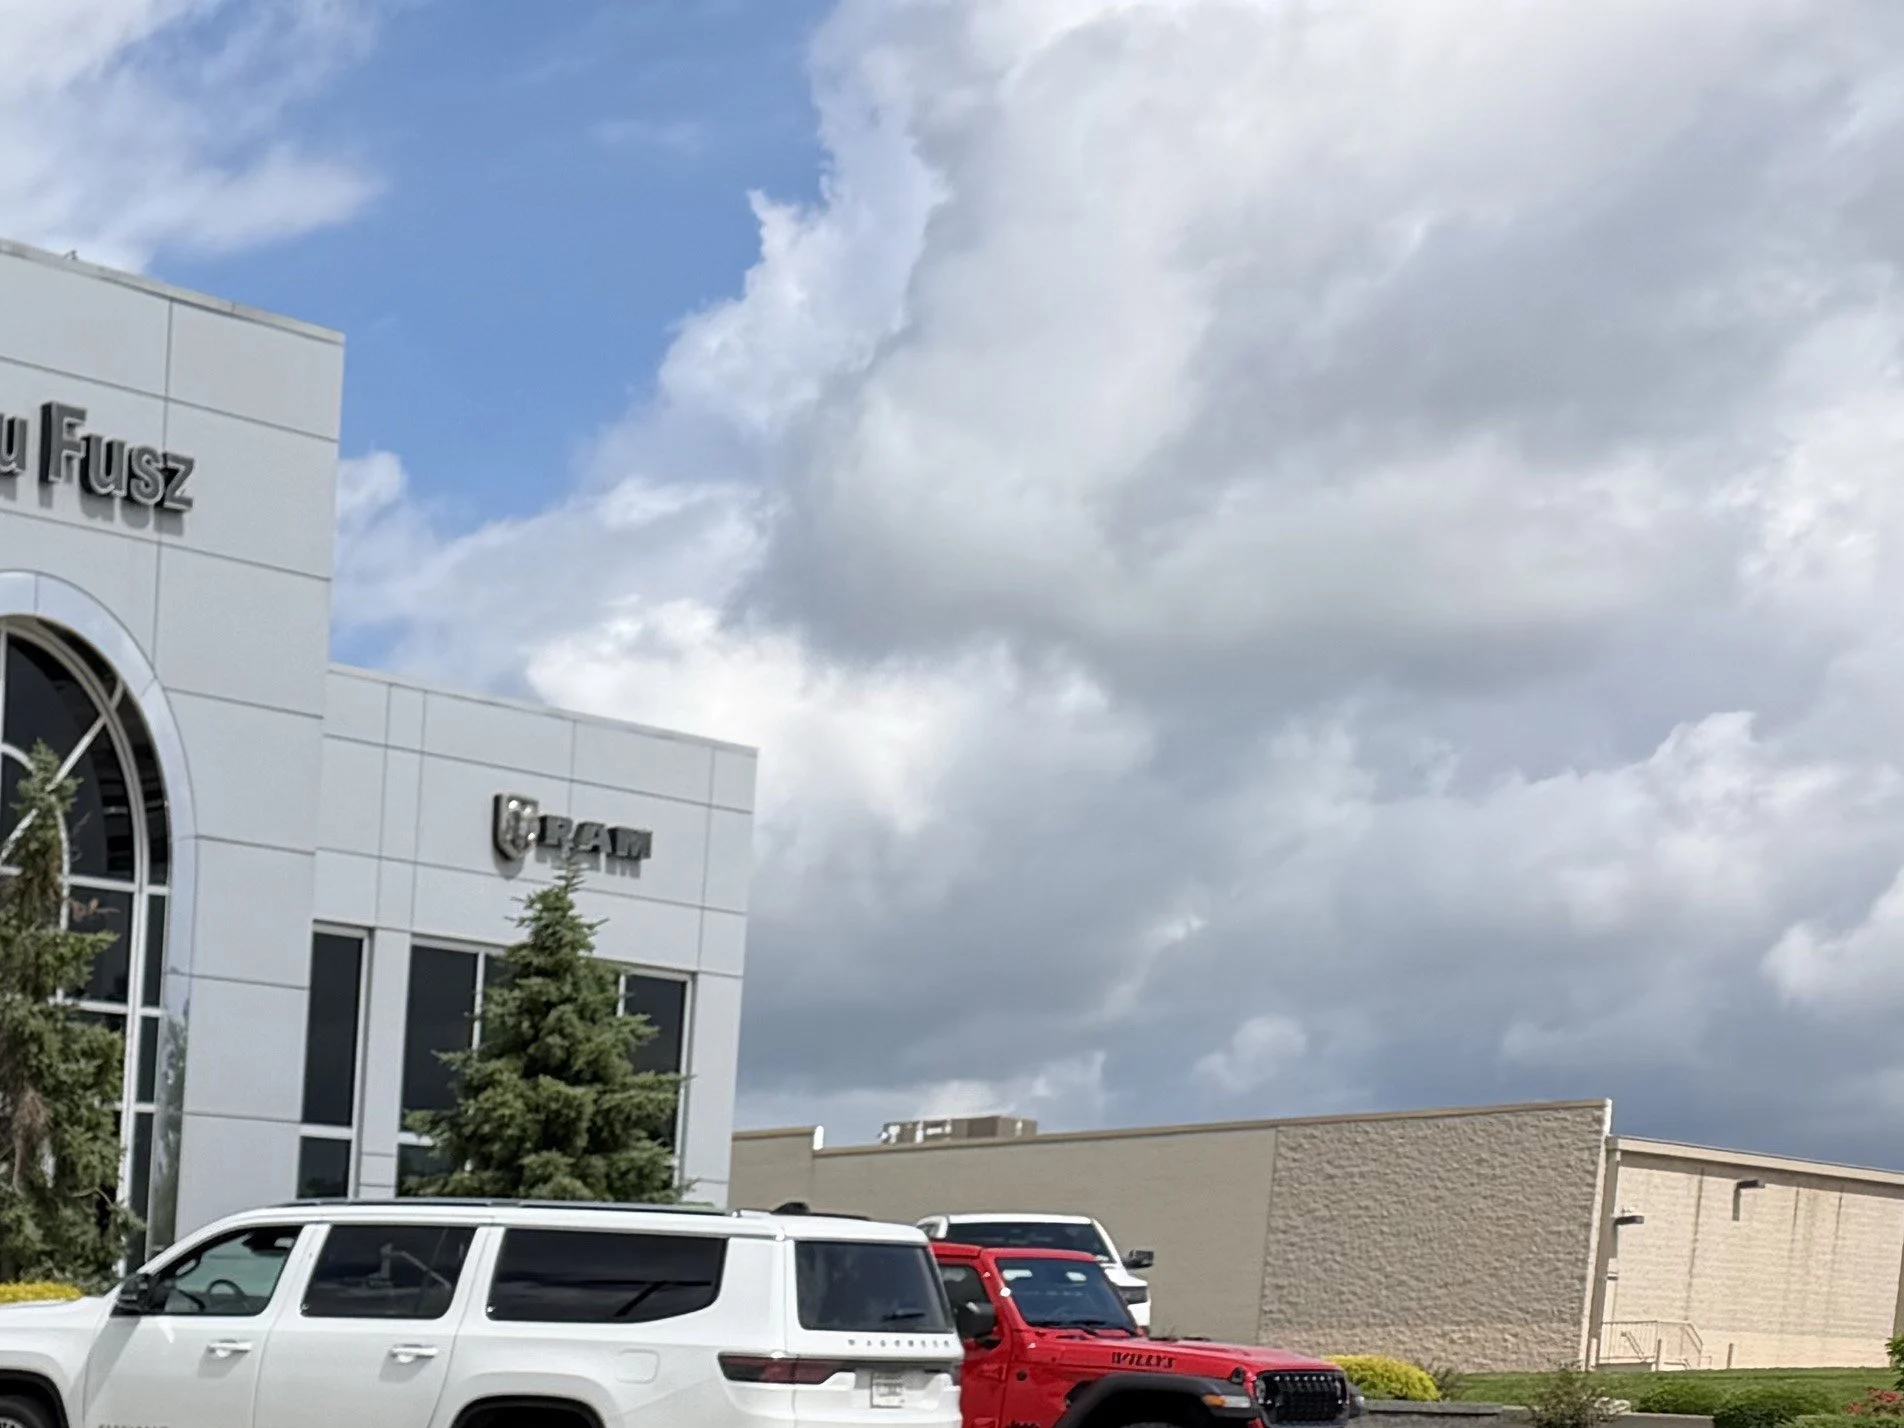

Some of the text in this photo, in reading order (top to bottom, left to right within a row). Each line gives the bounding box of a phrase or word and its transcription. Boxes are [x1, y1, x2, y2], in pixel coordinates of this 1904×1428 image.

[39, 400, 195, 512] Fusz
[537, 814, 653, 860] RAM
[1111, 1351, 1177, 1369] WILLYS
